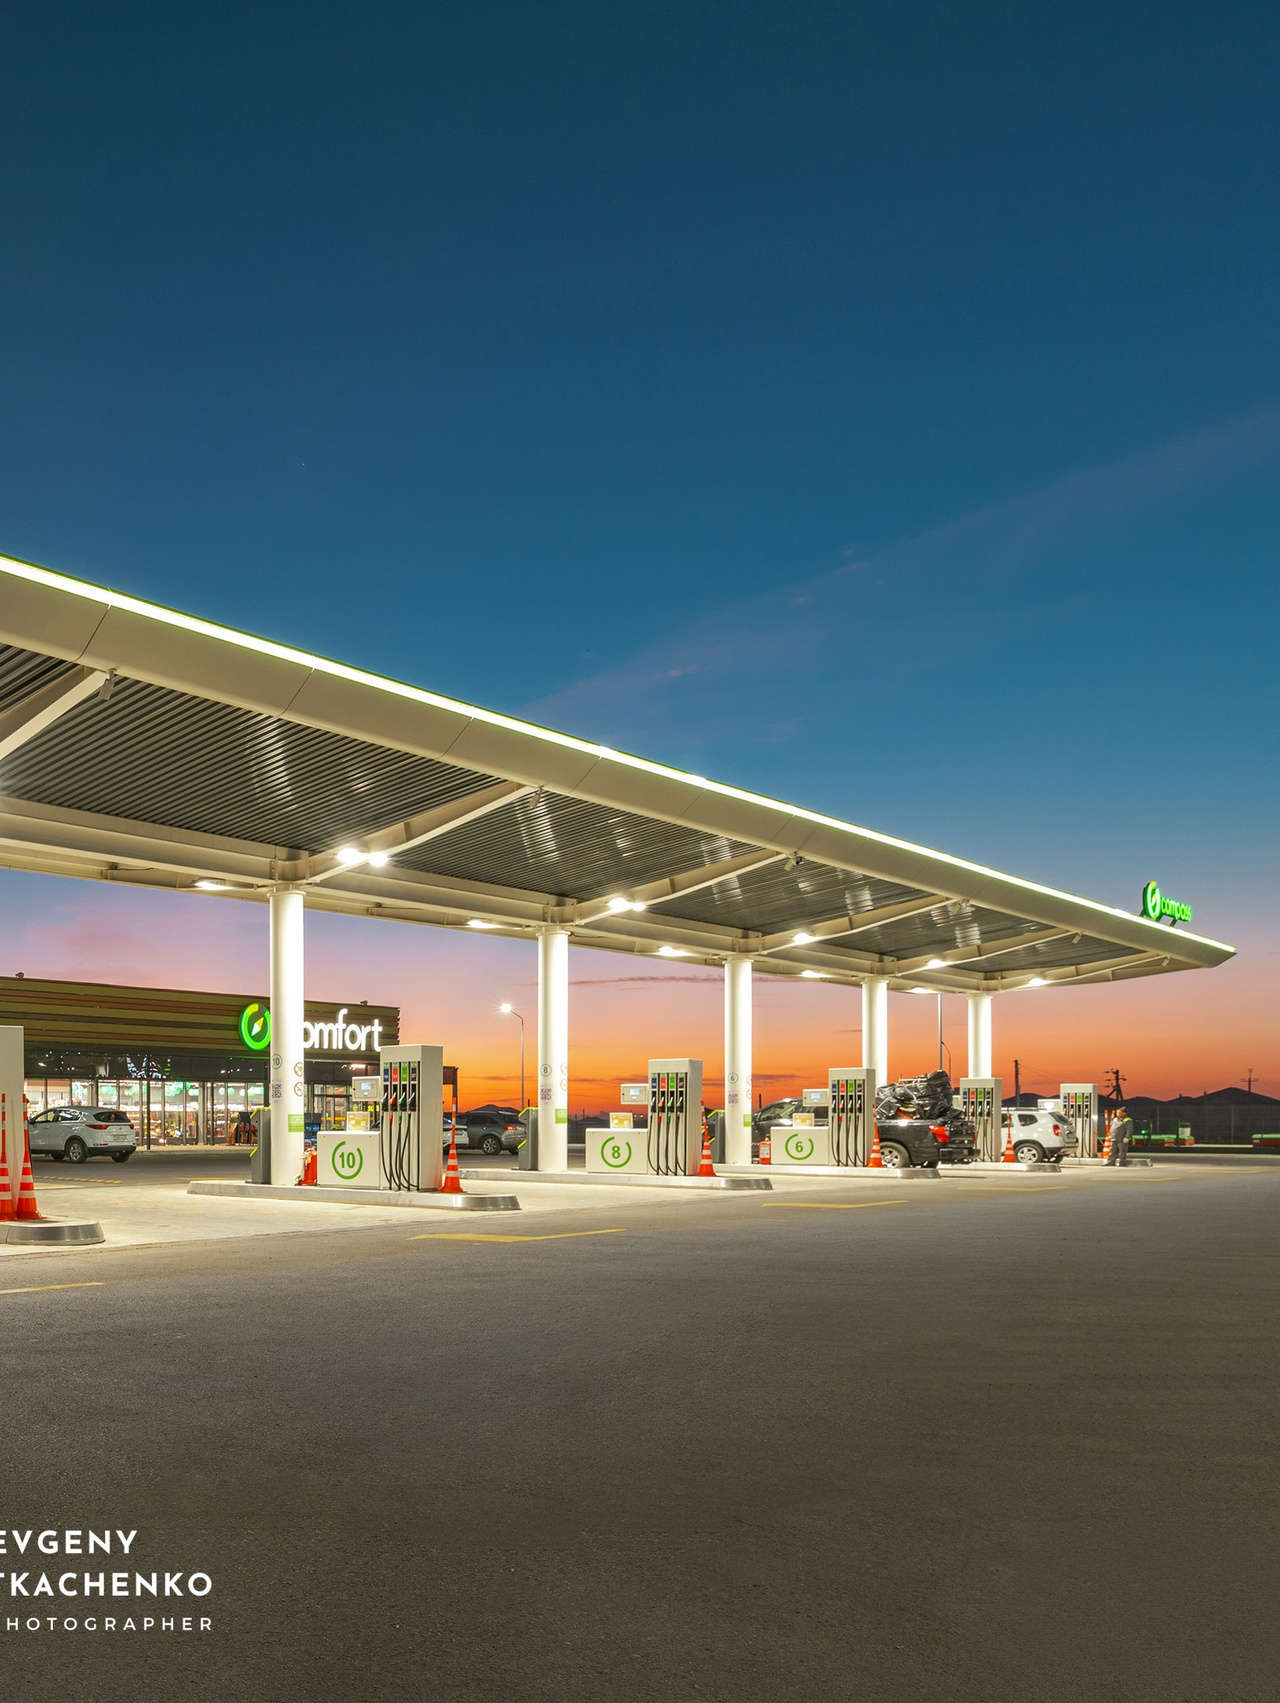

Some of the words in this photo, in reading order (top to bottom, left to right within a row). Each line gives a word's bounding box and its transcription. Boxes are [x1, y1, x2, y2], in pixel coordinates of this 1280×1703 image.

[1160, 896, 1192, 922] compass
[303, 1008, 383, 1052] omfort
[611, 1145, 621, 1159] 8
[795, 1140, 804, 1153] 6
[339, 1151, 356, 1169] 10
